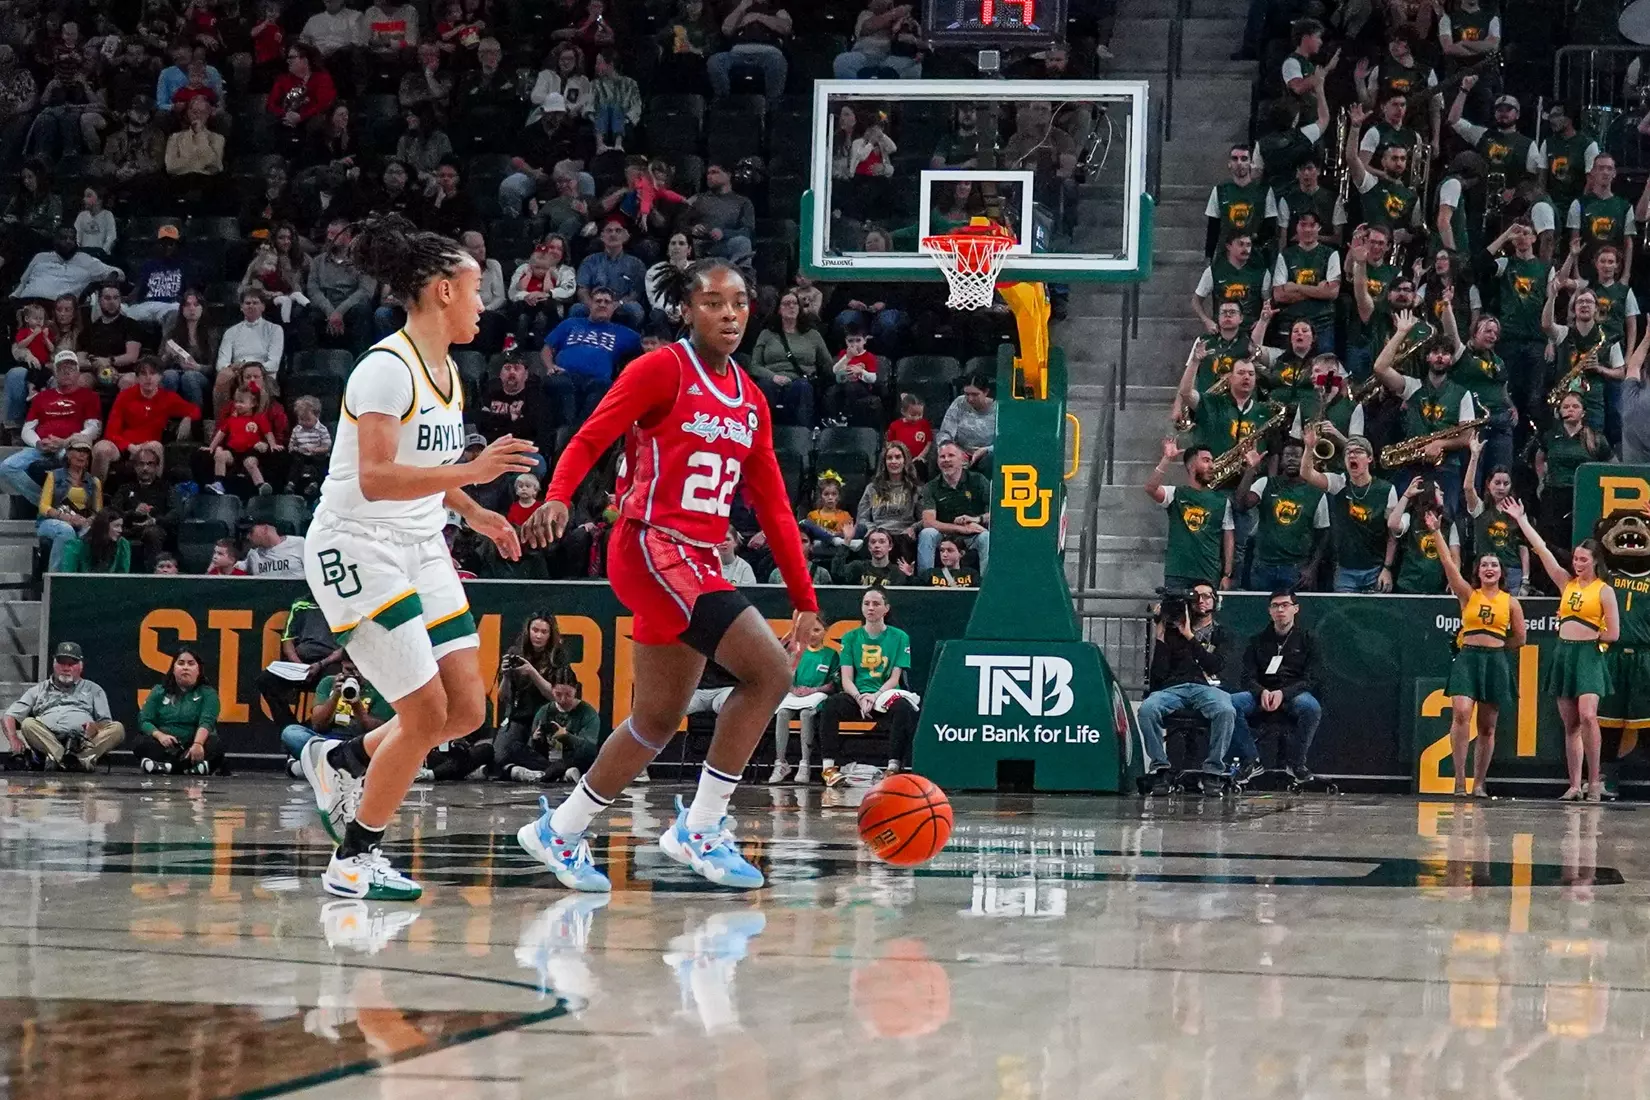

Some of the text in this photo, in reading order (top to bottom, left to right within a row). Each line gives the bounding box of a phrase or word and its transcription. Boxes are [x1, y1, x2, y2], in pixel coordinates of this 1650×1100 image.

[681, 451, 741, 518] 22
[1001, 464, 1053, 528] BU
[258, 559, 290, 574] BAYLOR
[317, 548, 363, 598] BU
[932, 575, 972, 586] BAOR
[1614, 578, 1650, 593] BAYLOR
[1625, 591, 1633, 612] 1
[1478, 603, 1496, 625] BU
[934, 724, 1100, 743] Your Bank for Life
